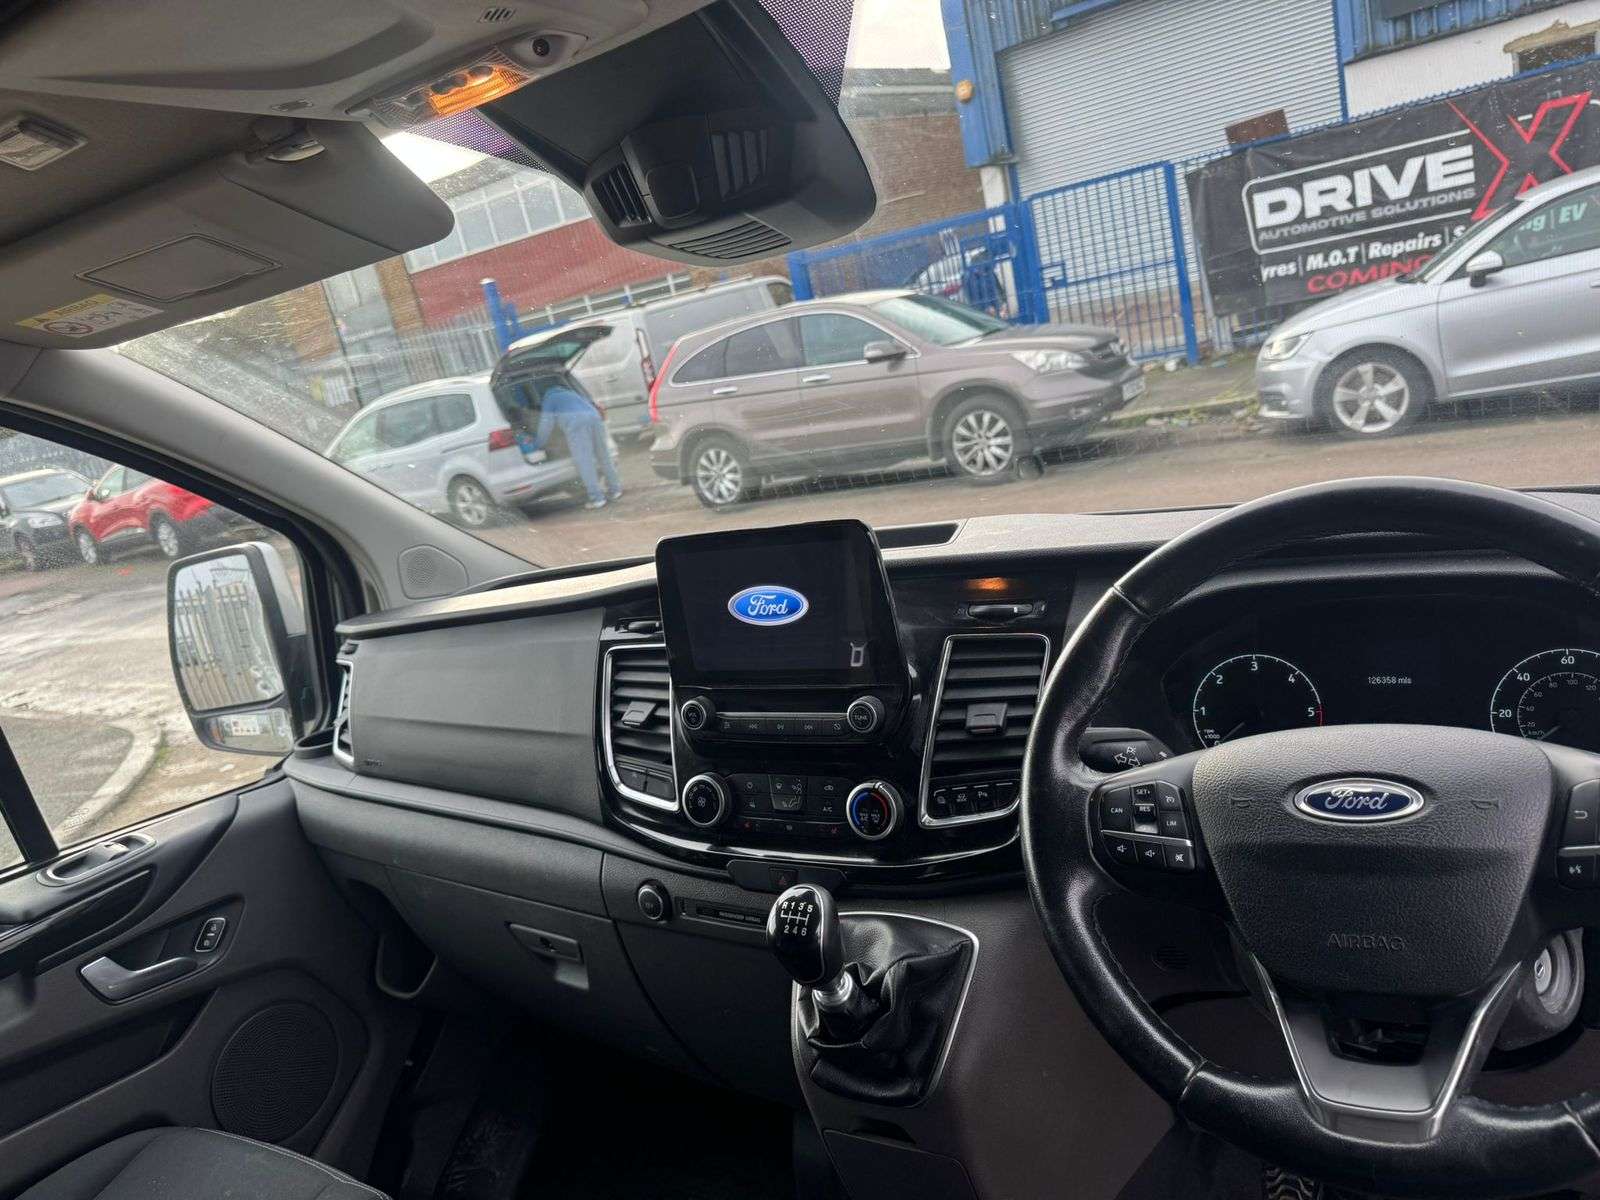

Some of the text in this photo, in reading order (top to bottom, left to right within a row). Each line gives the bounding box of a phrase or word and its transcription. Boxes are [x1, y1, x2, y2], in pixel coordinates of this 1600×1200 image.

[1252, 145, 1476, 230] DRIVE
[1258, 188, 1476, 242] AUTOMOTIVE SOLUTIONS
[1306, 245, 1359, 271] M.O.T
[1370, 231, 1442, 259] Repairs
[747, 594, 789, 616] Ford
[1560, 655, 1575, 665] 60
[1250, 661, 1259, 671] 3
[1215, 674, 1224, 685] 2
[1288, 673, 1296, 684] 4
[1368, 676, 1397, 685] 126358
[1516, 672, 1530, 681] 40
[1200, 706, 1206, 716] 1
[1307, 706, 1315, 717] 5
[1498, 708, 1512, 718] 20
[1325, 786, 1390, 811] Ford
[781, 901, 814, 913] R 1 3 5
[783, 924, 807, 936] 2 4 6
[1327, 932, 1407, 952] AIRBAG
